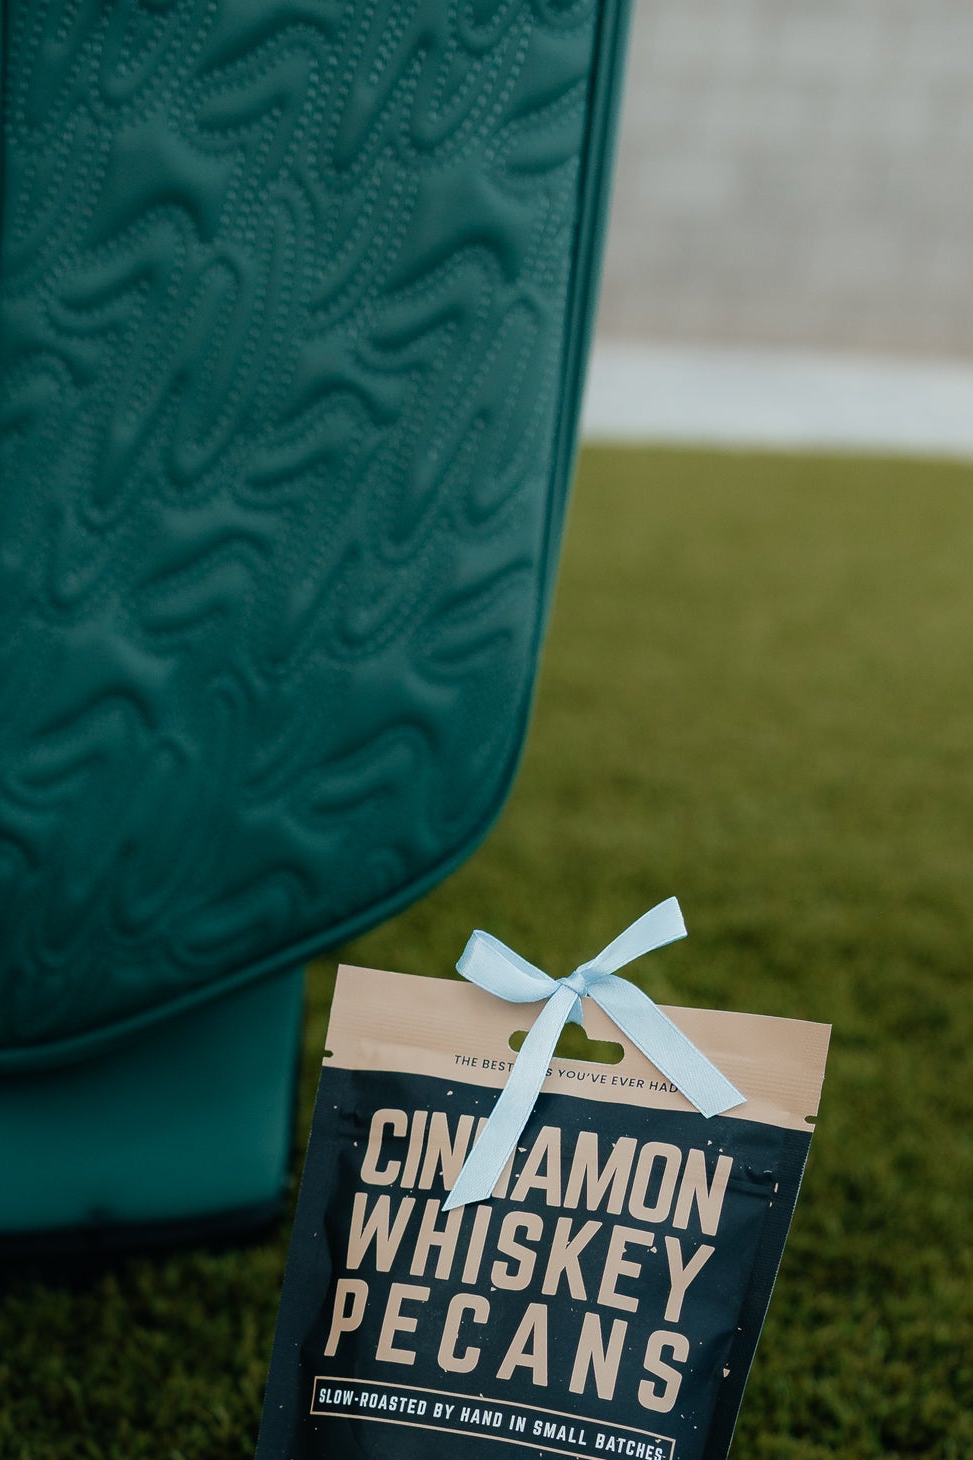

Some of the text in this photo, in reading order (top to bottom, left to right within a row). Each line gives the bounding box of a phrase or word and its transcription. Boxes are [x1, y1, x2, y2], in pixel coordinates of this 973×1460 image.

[454, 1054, 478, 1068] THE
[482, 1059, 514, 1072] BEST
[558, 1069, 607, 1085] YOU'VE
[611, 1076, 644, 1090] EVER
[649, 1080, 679, 1094] HAD
[346, 1191, 716, 1323] WHISKEY
[323, 1278, 690, 1413] PECANS
[318, 1387, 428, 1416] SLOW-ROASTED
[433, 1402, 455, 1420] BY
[460, 1406, 503, 1428] HAND
[509, 1414, 527, 1433] IN
[532, 1419, 587, 1446] SMALL
